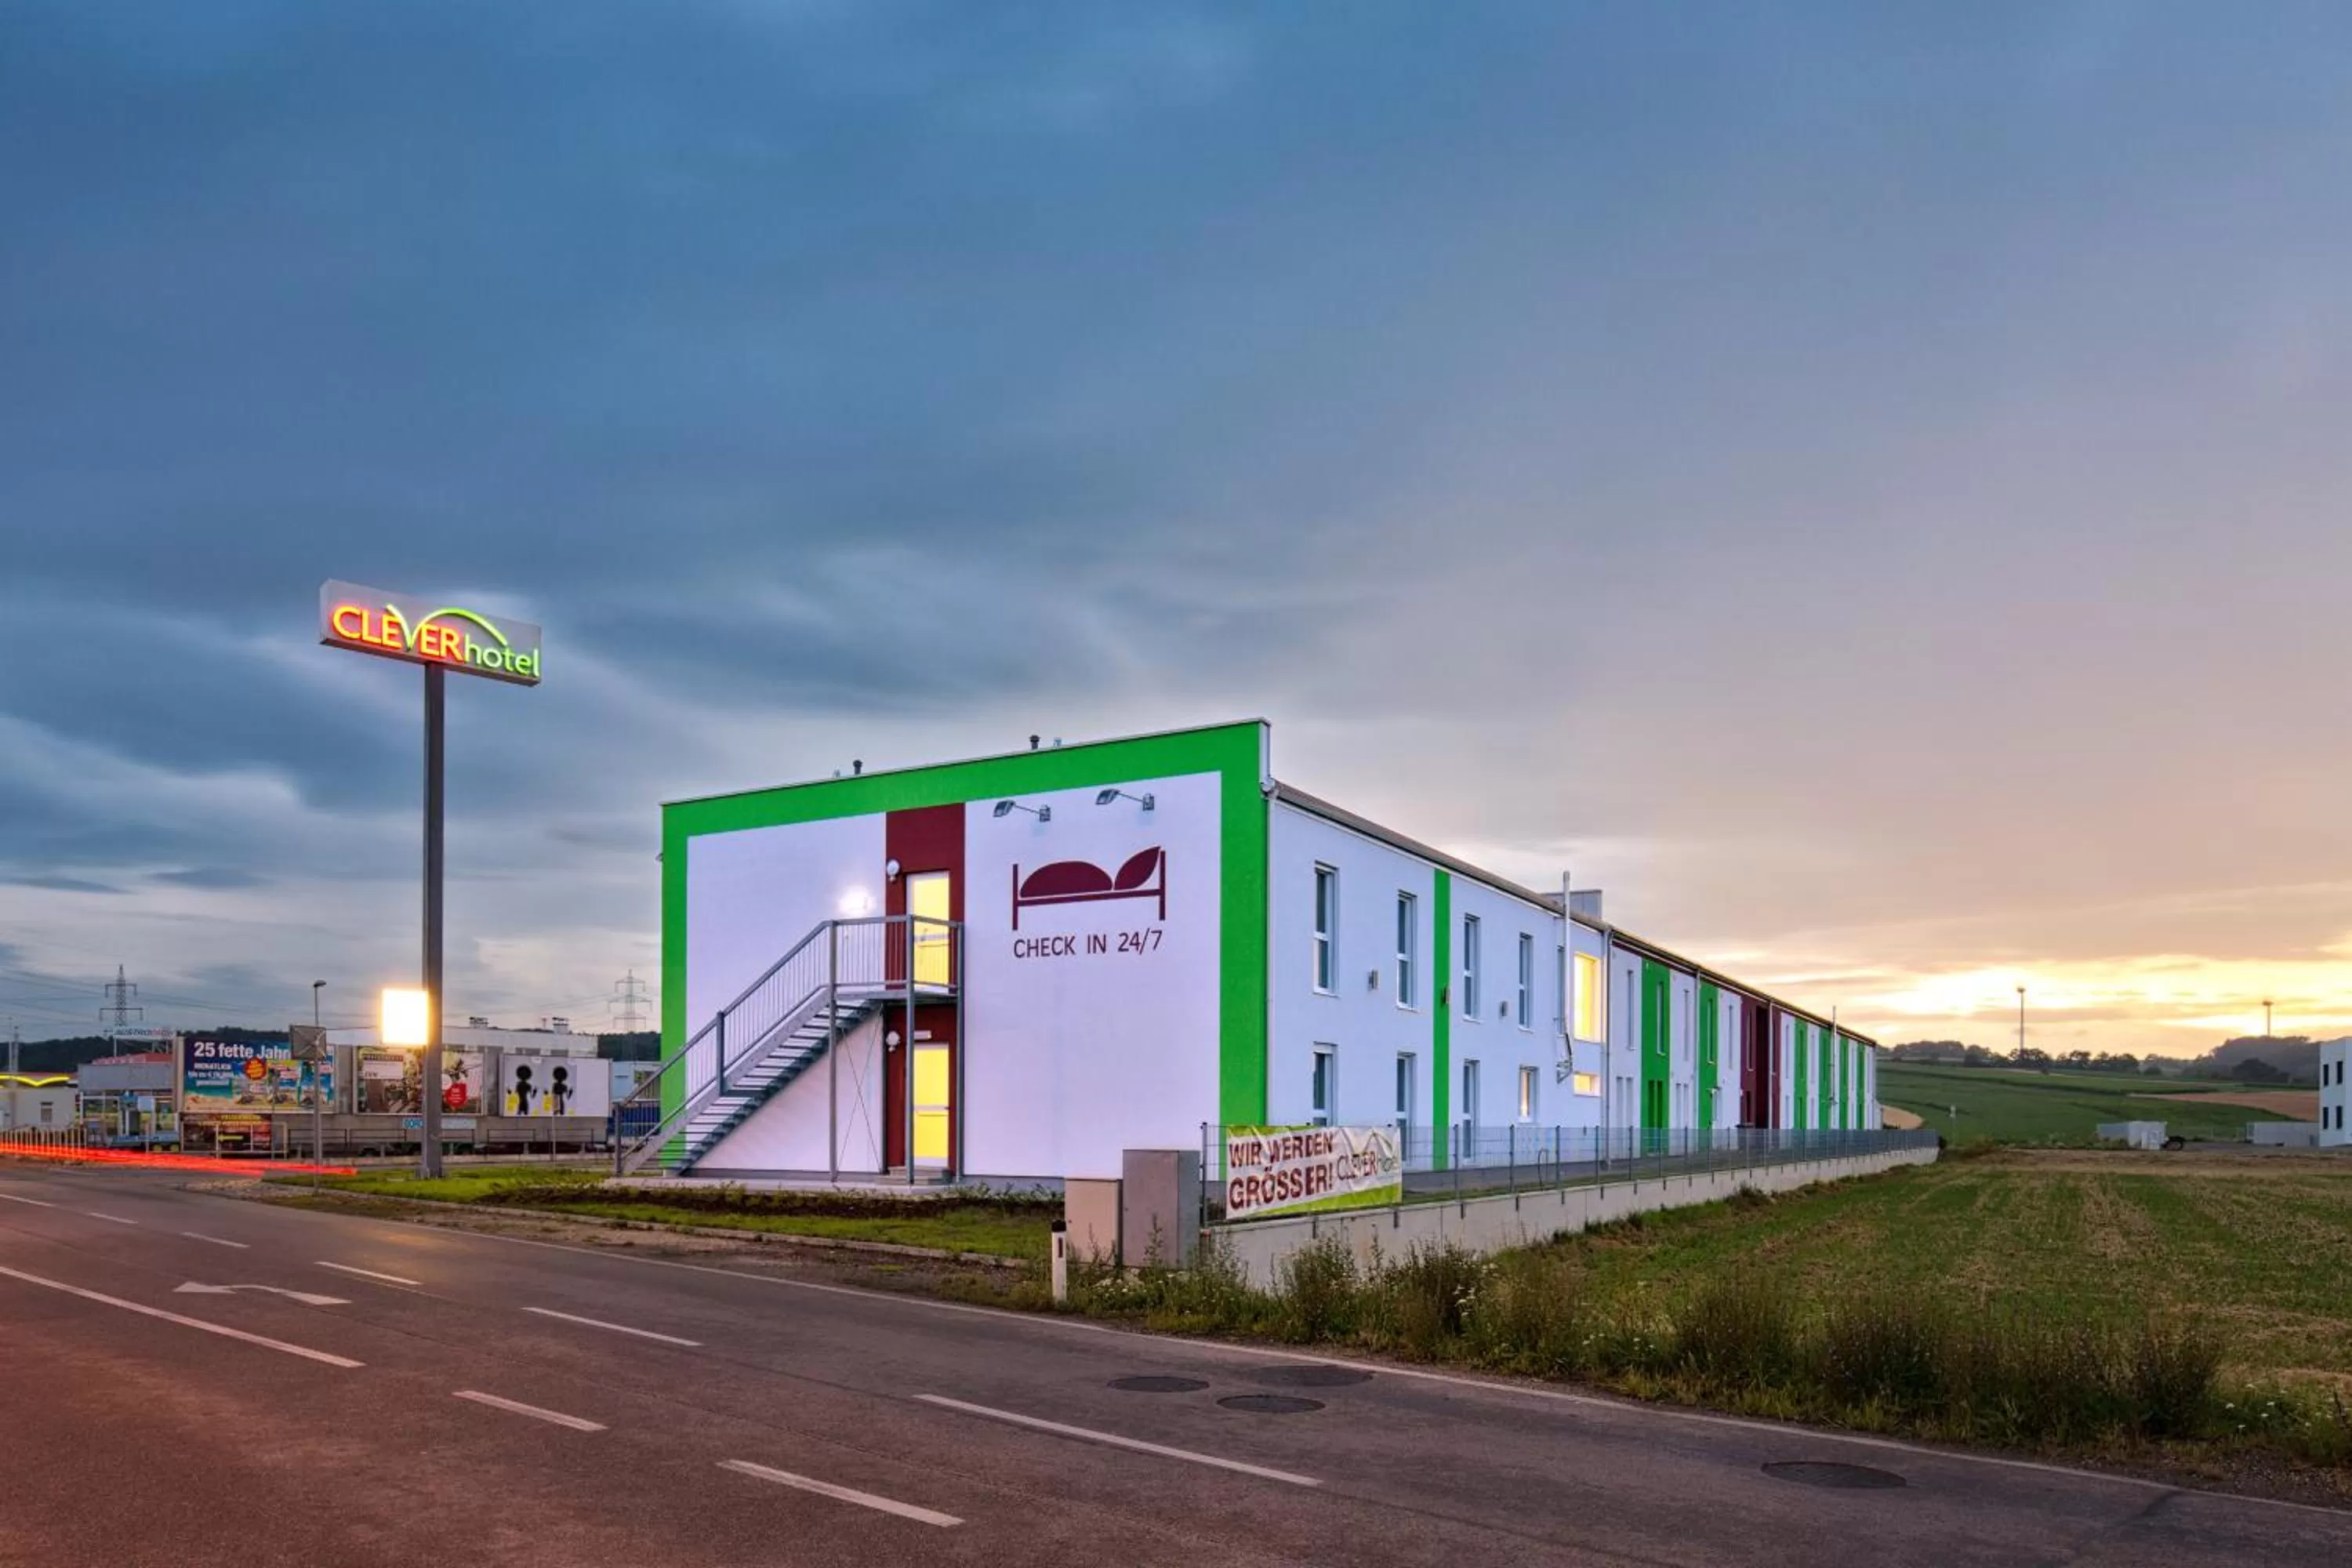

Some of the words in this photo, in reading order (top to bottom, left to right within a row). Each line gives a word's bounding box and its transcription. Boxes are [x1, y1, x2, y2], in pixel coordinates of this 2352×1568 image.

[1013, 935, 1076, 959] CHECK
[1087, 934, 1107, 955] IN
[1117, 927, 1163, 956] 24/7
[194, 1041, 216, 1058] 25
[217, 1043, 254, 1059] fette
[1229, 1142, 1262, 1168] WIR
[1267, 1131, 1334, 1163] WERDEN
[1229, 1162, 1334, 1210] GRÖSSER!
